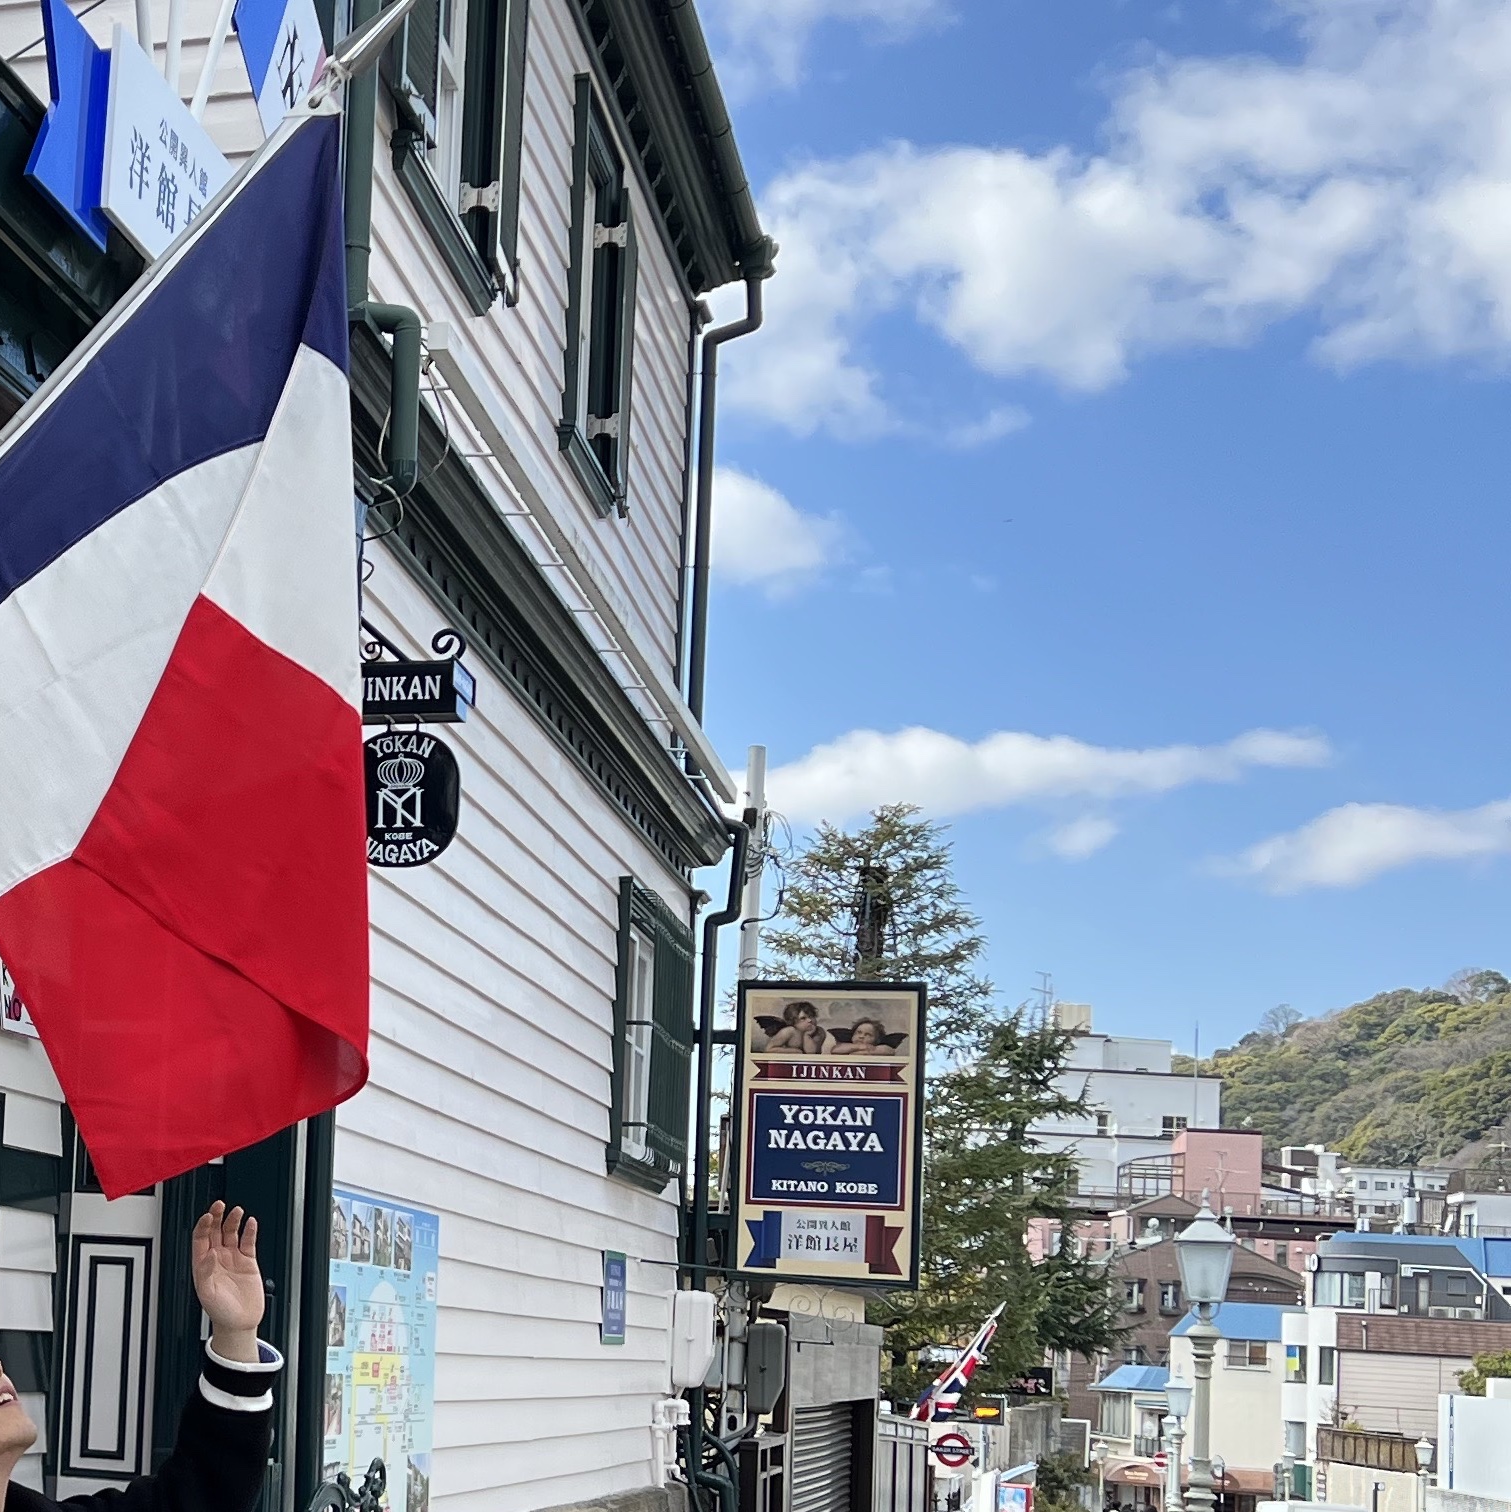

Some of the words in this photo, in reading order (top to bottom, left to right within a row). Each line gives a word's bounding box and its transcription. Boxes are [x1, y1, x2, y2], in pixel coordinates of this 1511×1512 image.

[384, 832, 413, 841] KOBE
[791, 1064, 868, 1079] IJINKAN
[768, 1129, 884, 1152] NAGAYA
[771, 1180, 829, 1193] KITANO
[835, 1182, 878, 1195] KOBE
[795, 1218, 852, 1232] 公開異人館
[788, 1233, 859, 1254] 洋館長屋
